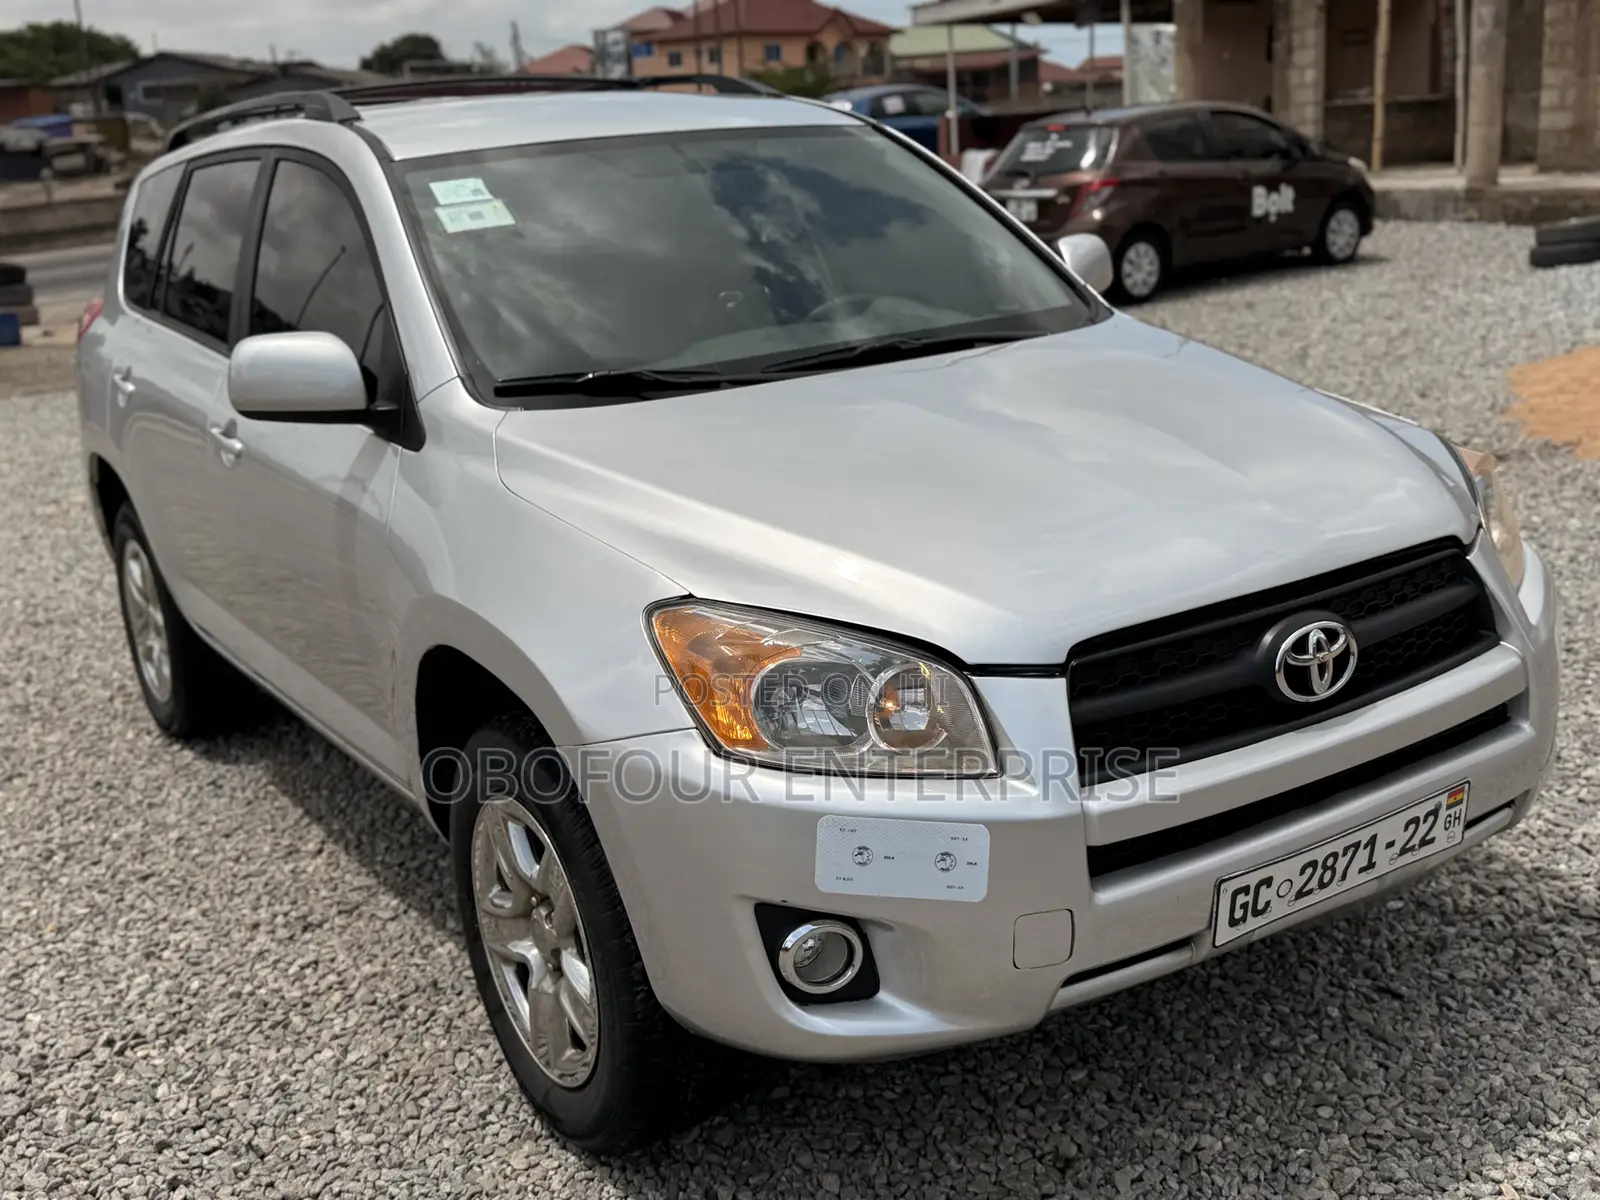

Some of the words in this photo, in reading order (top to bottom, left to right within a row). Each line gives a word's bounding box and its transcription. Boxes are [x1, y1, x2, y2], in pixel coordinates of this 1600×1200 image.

[1444, 808, 1462, 831] GH
[1228, 876, 1273, 928] GC
[1294, 808, 1439, 901] 2871-22
